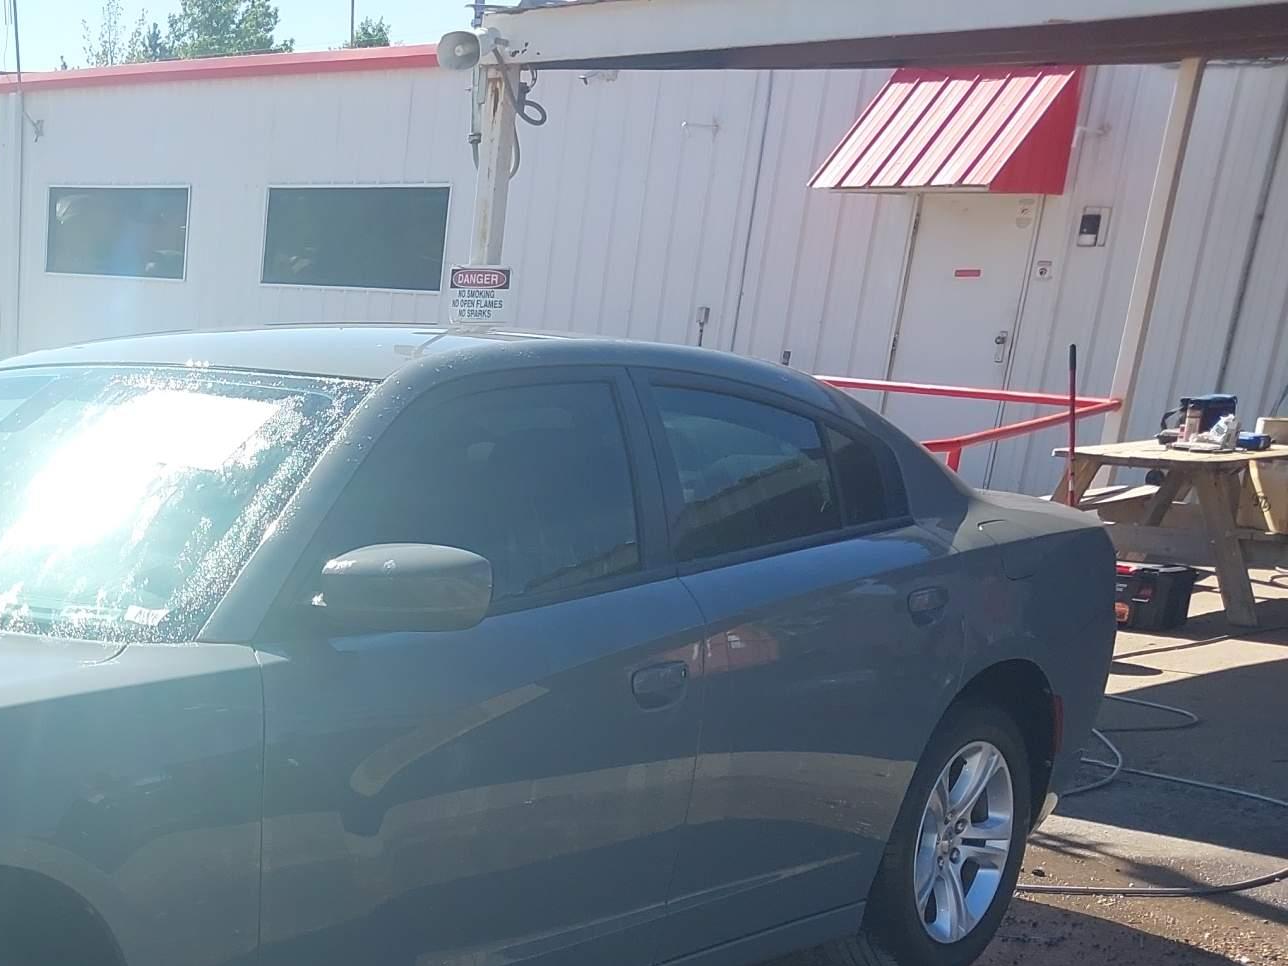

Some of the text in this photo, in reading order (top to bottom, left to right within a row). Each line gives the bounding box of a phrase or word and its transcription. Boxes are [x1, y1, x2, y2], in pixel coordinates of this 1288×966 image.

[457, 273, 499, 285] DANGER
[458, 290, 495, 299] NO SMOKING
[452, 299, 504, 309] NO OPEN FLAMES
[458, 309, 492, 319] NO SPARKS
